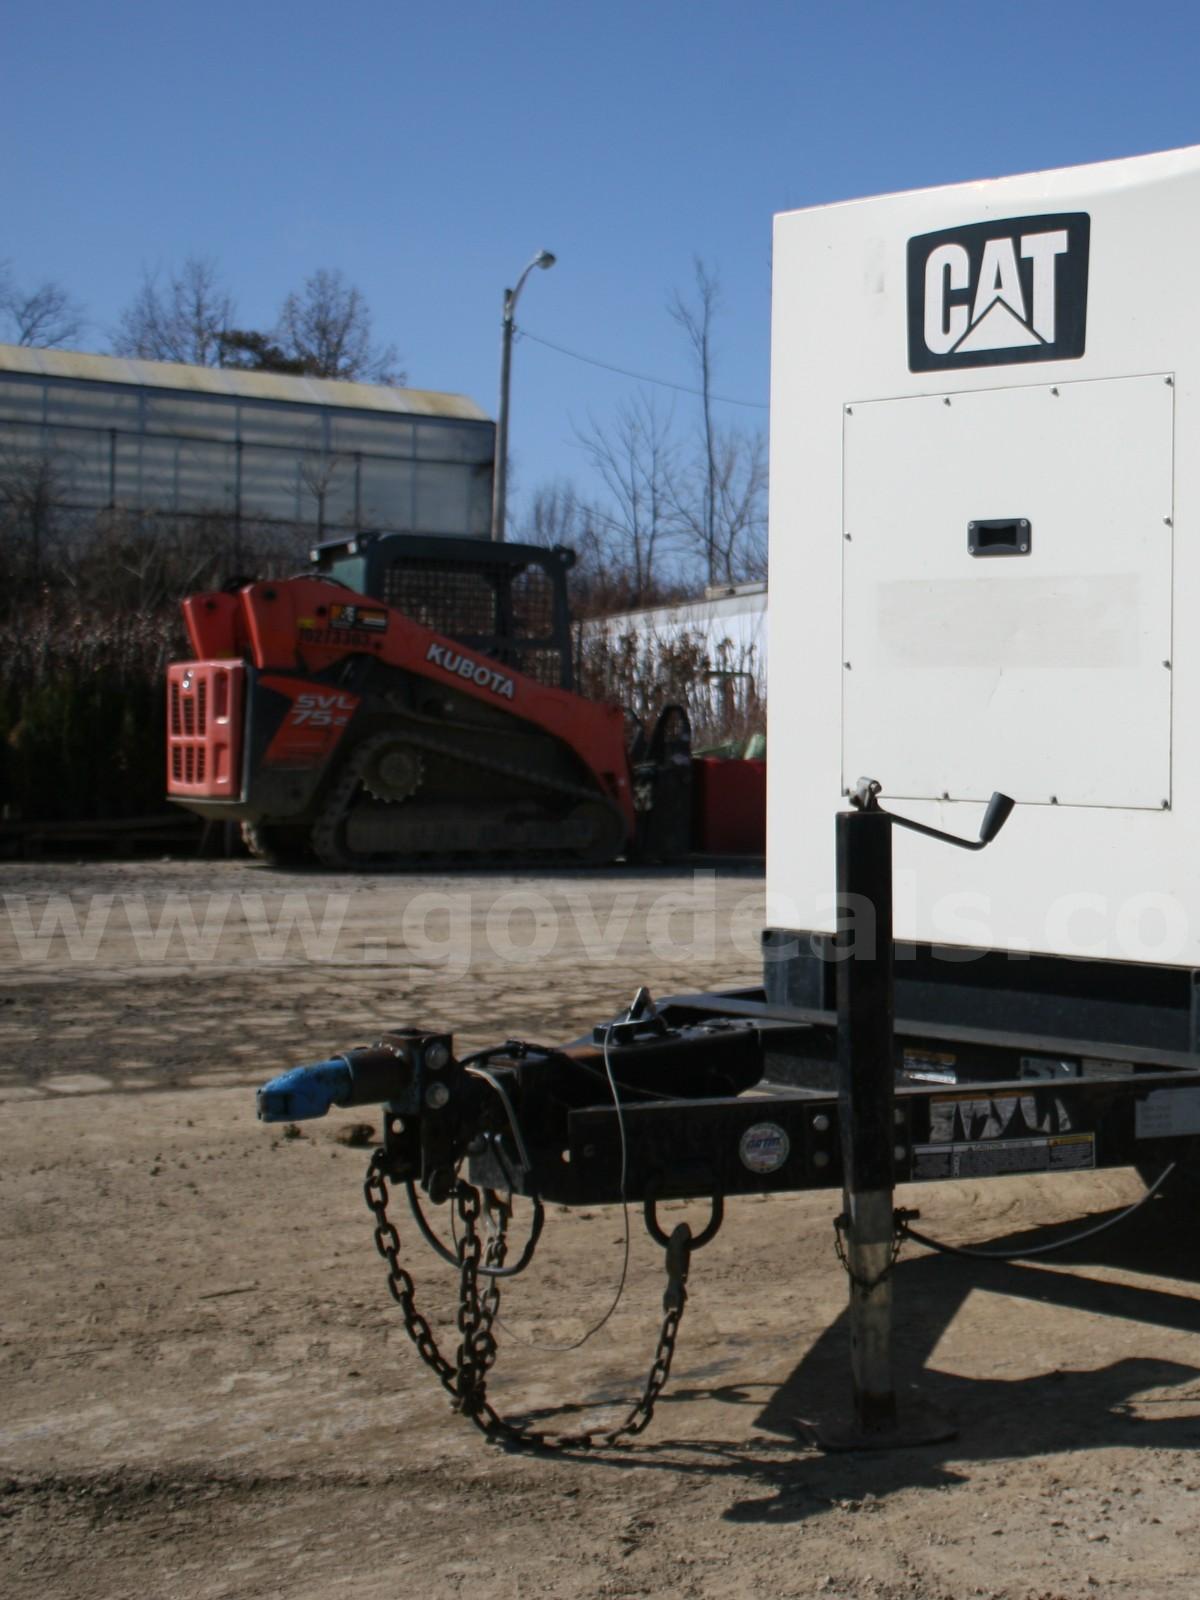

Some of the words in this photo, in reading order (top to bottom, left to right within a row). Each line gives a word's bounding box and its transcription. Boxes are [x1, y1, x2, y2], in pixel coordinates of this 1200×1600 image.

[924, 229, 1068, 355] CAT
[426, 643, 514, 699] KUBOTA
[295, 693, 353, 709] SVL
